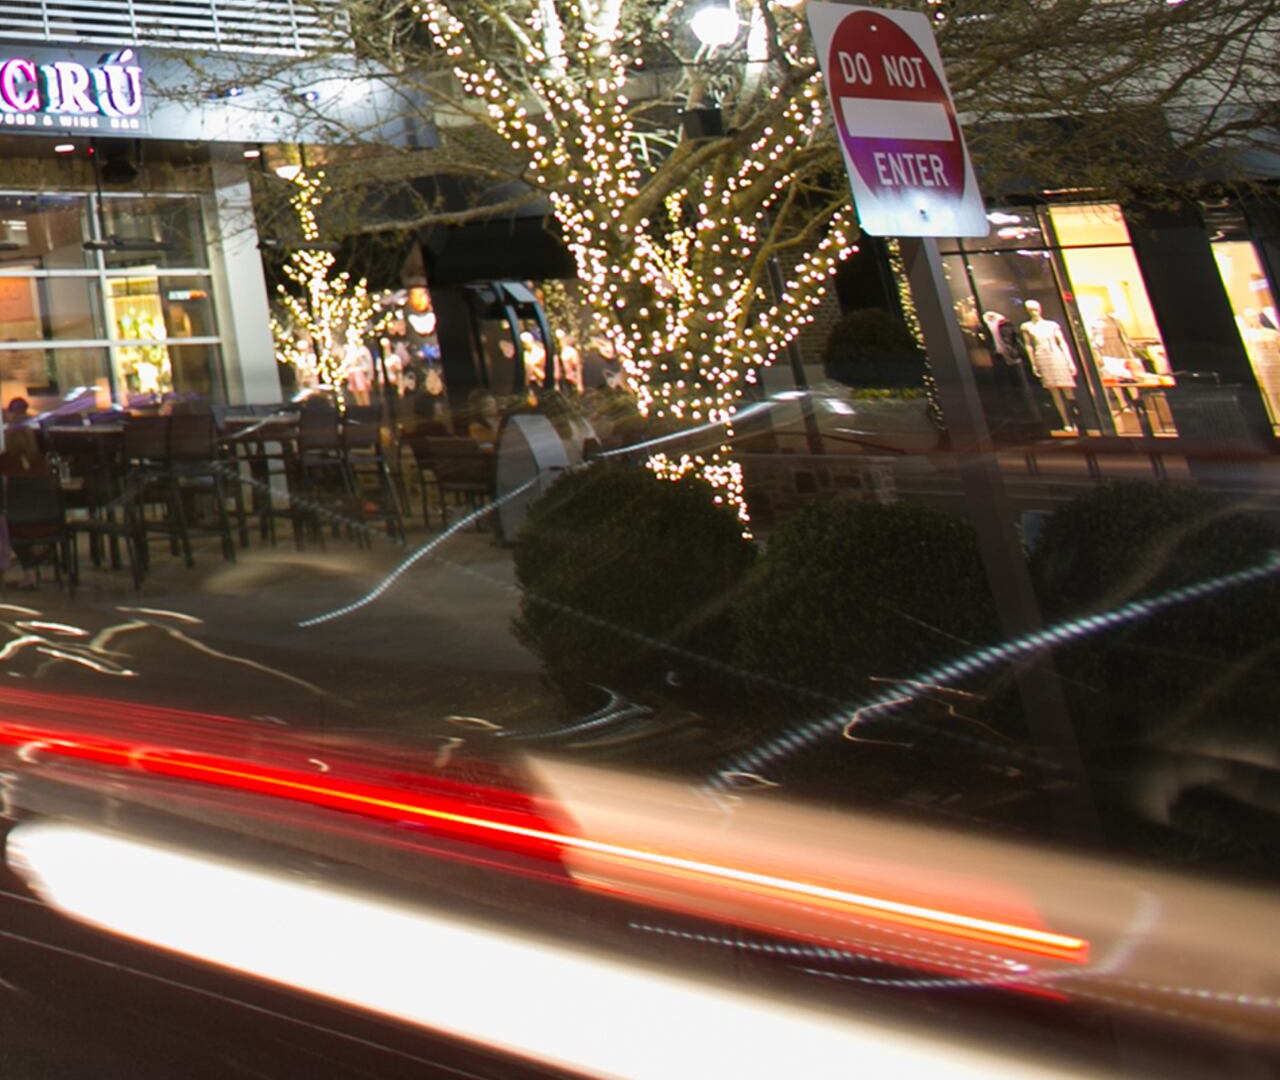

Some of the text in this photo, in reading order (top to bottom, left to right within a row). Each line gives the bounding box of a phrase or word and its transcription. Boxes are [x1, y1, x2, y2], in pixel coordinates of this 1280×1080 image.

[838, 50, 927, 89] DO NOT
[59, 116, 100, 128] WINE
[110, 117, 140, 129] BAR
[873, 151, 950, 188] ENTER
